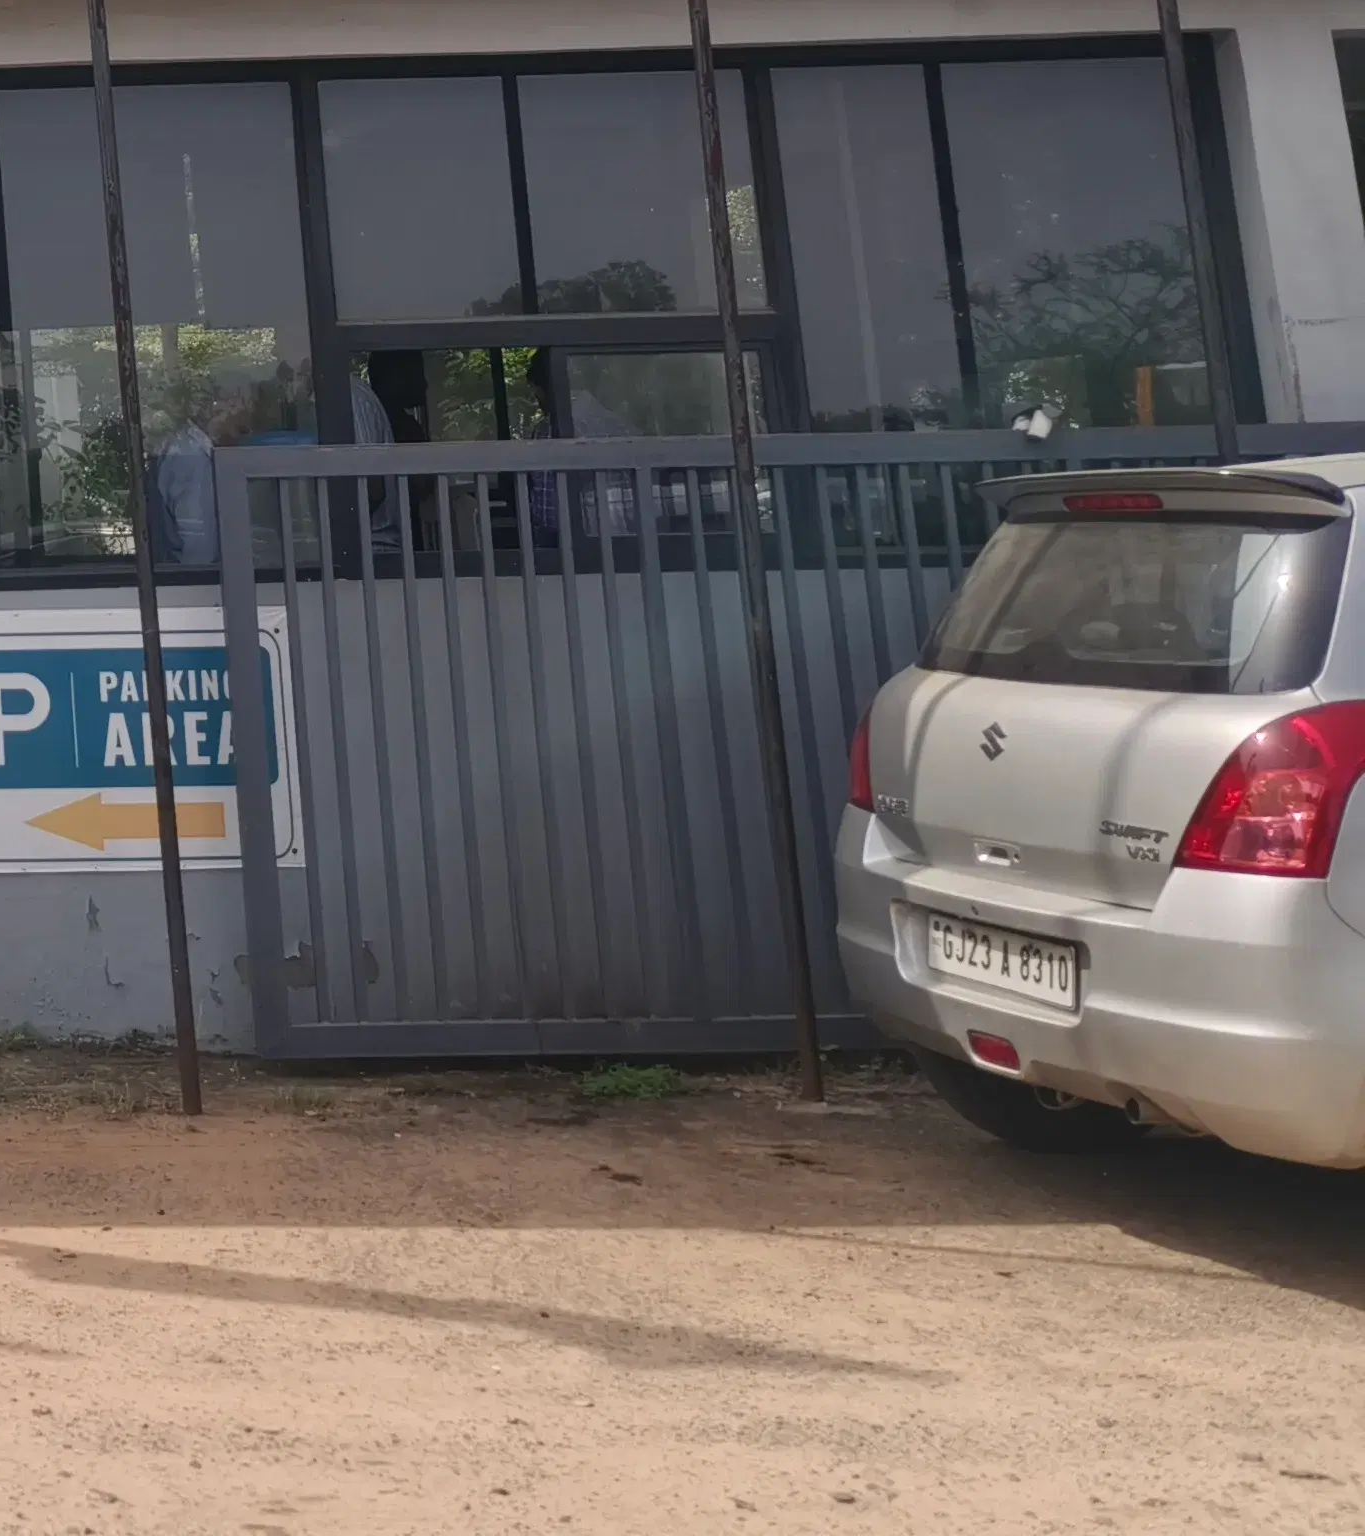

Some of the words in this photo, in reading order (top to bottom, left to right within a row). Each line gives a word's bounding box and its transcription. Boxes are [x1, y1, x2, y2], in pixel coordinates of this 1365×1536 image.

[98, 668, 230, 703] PAKIN
[942, 924, 992, 971] GJ23
[1000, 939, 1011, 978] A
[1019, 943, 1069, 993] 8310
